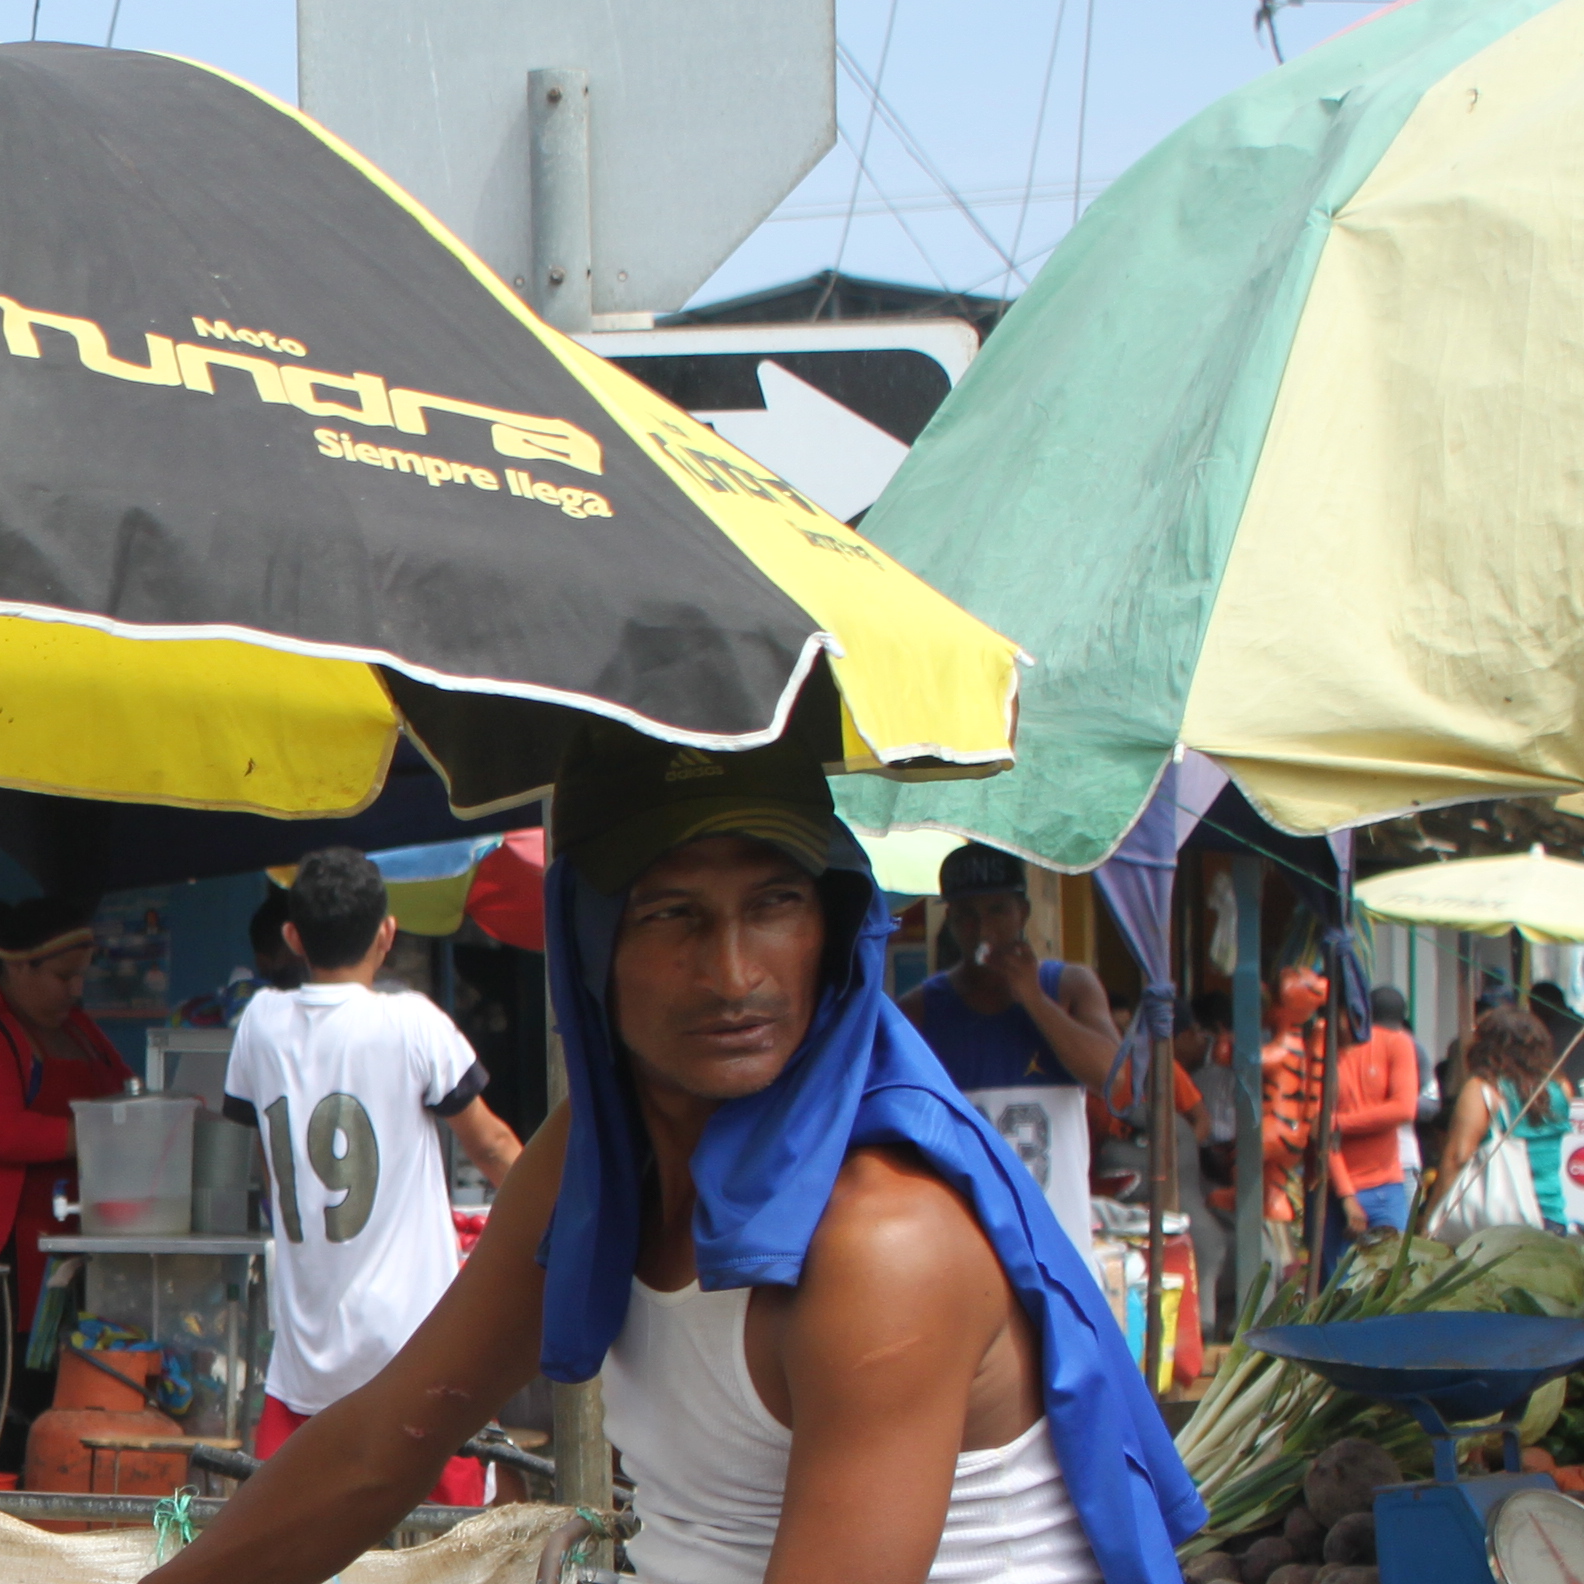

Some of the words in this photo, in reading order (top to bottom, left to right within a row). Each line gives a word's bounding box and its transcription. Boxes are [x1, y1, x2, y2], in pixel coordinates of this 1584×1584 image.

[191, 315, 309, 358] Moto
[313, 427, 500, 488] Siempre
[505, 468, 615, 519] llega
[262, 1092, 380, 1244] 19
